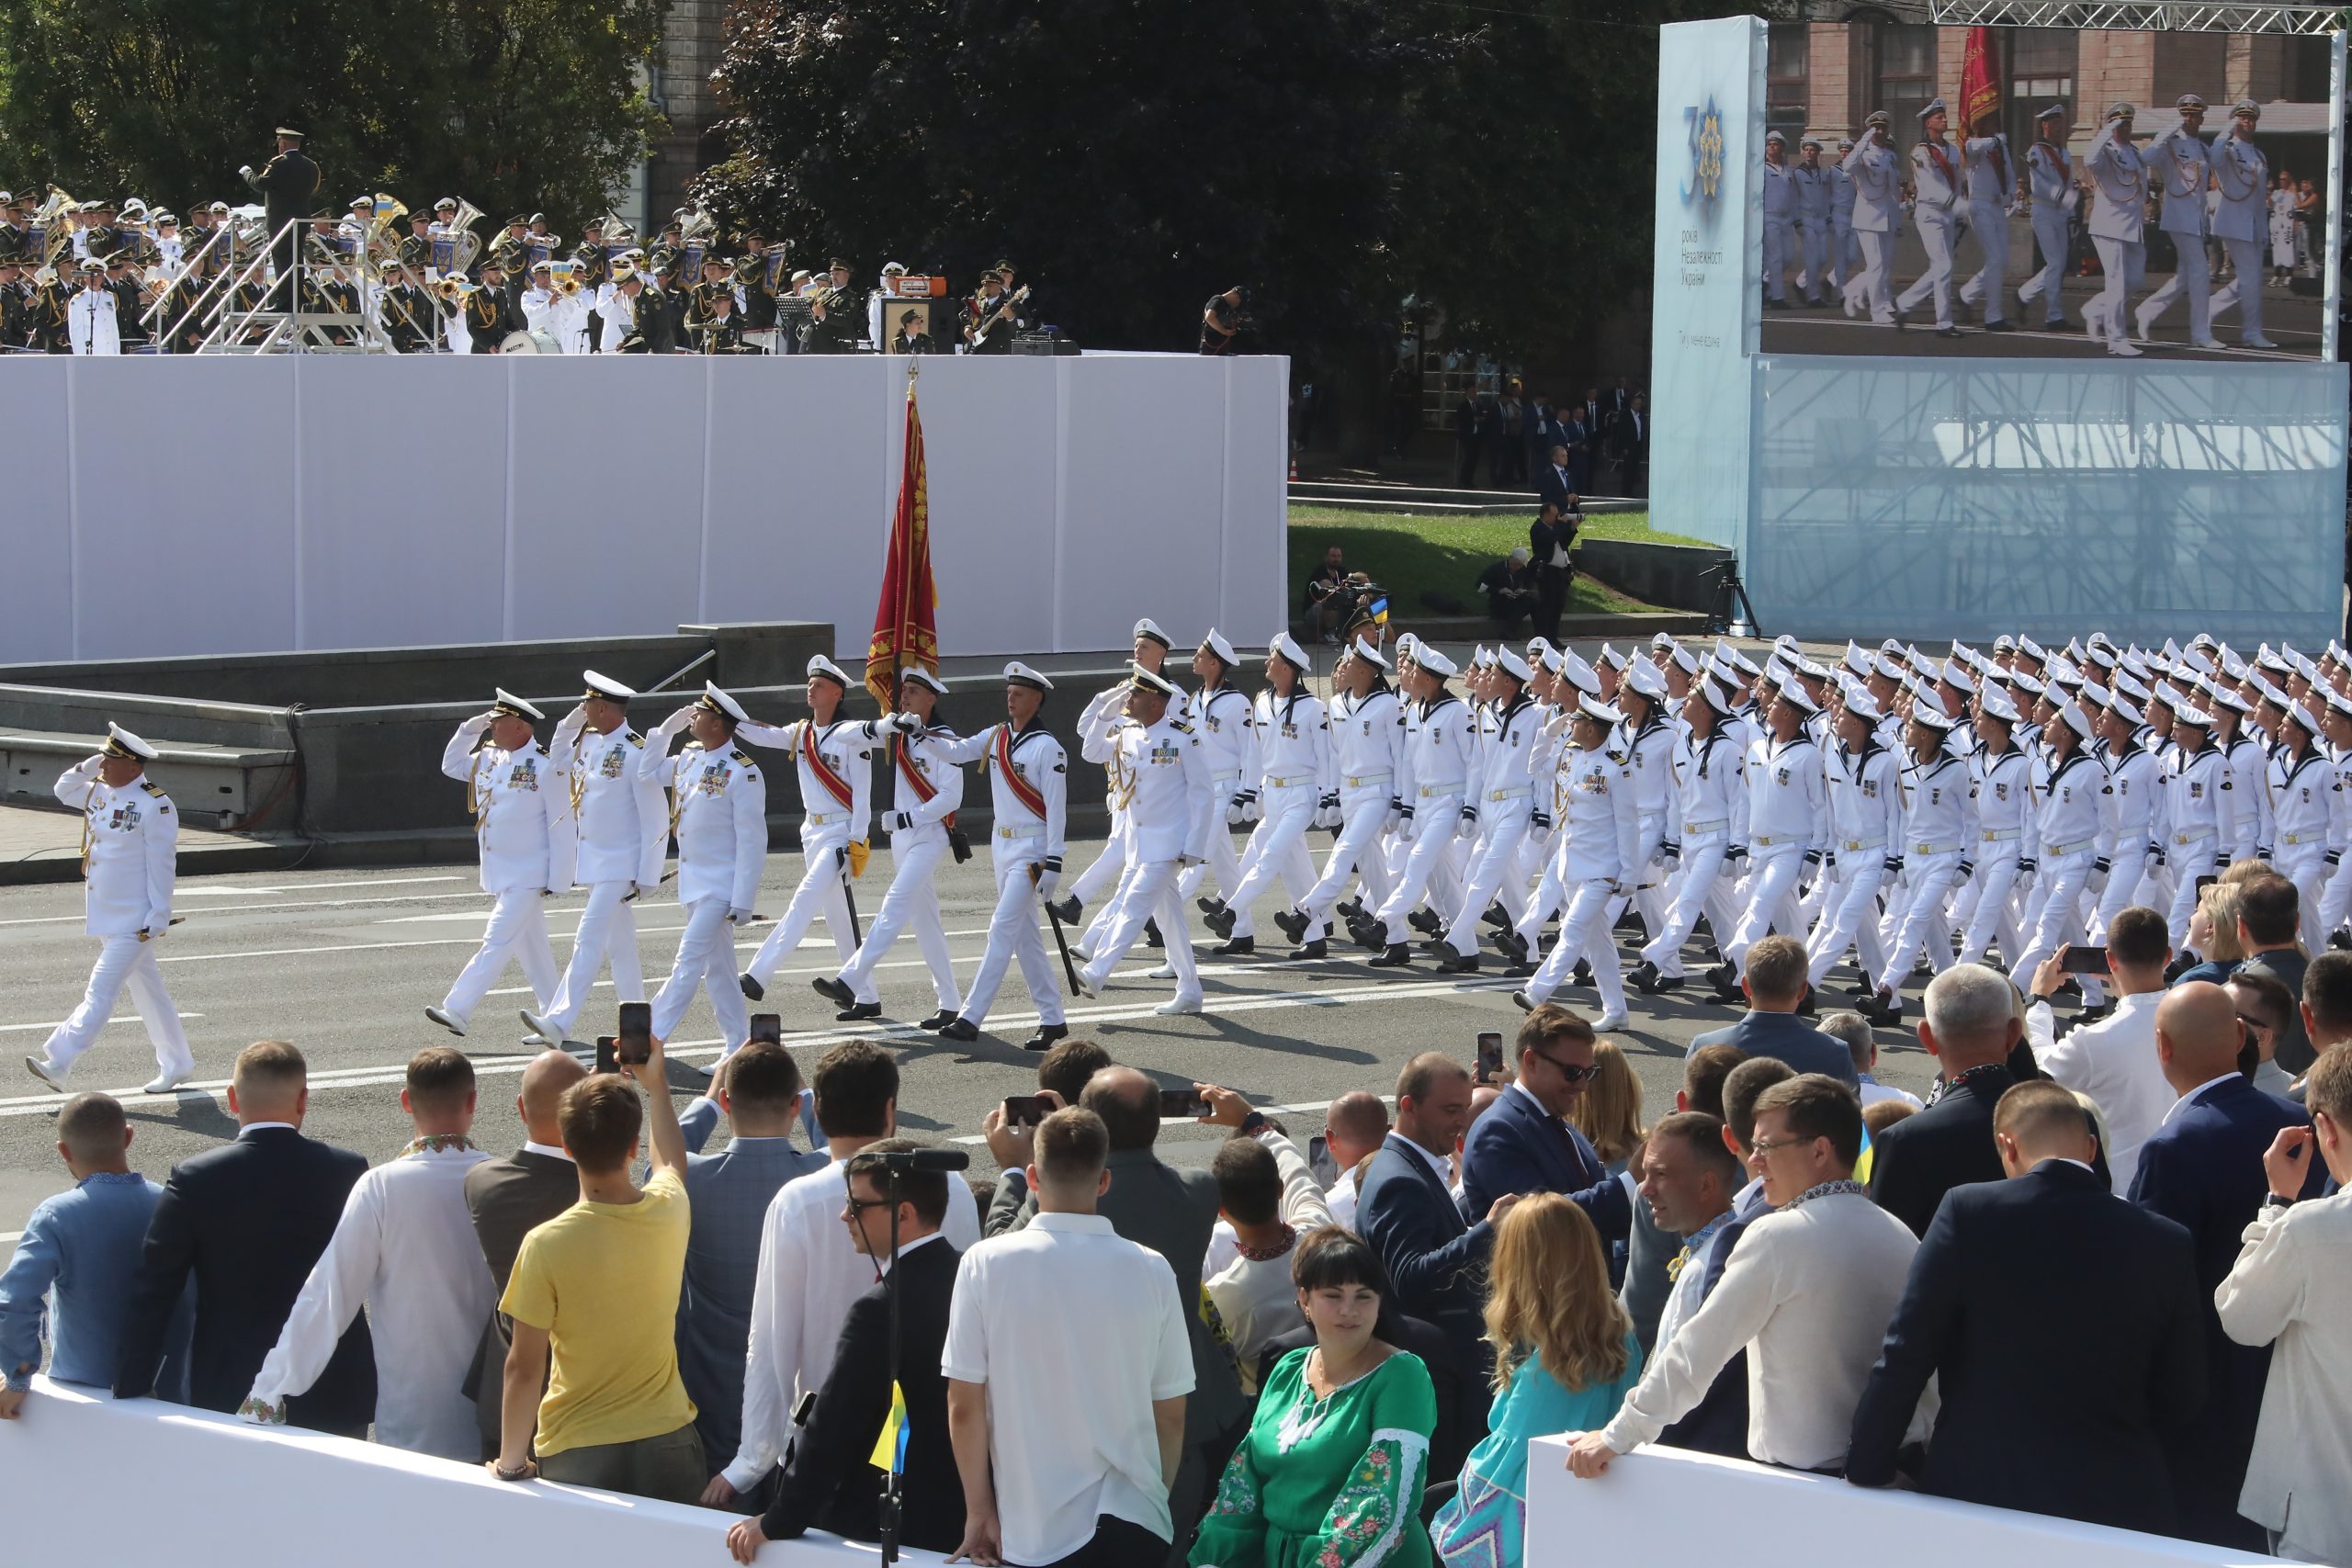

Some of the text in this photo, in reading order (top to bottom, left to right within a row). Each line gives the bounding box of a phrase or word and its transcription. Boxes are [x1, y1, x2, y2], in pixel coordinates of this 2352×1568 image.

[1681, 225, 1698, 245] років
[1681, 247, 1723, 265] Незалежності
[1681, 267, 1705, 289] України
